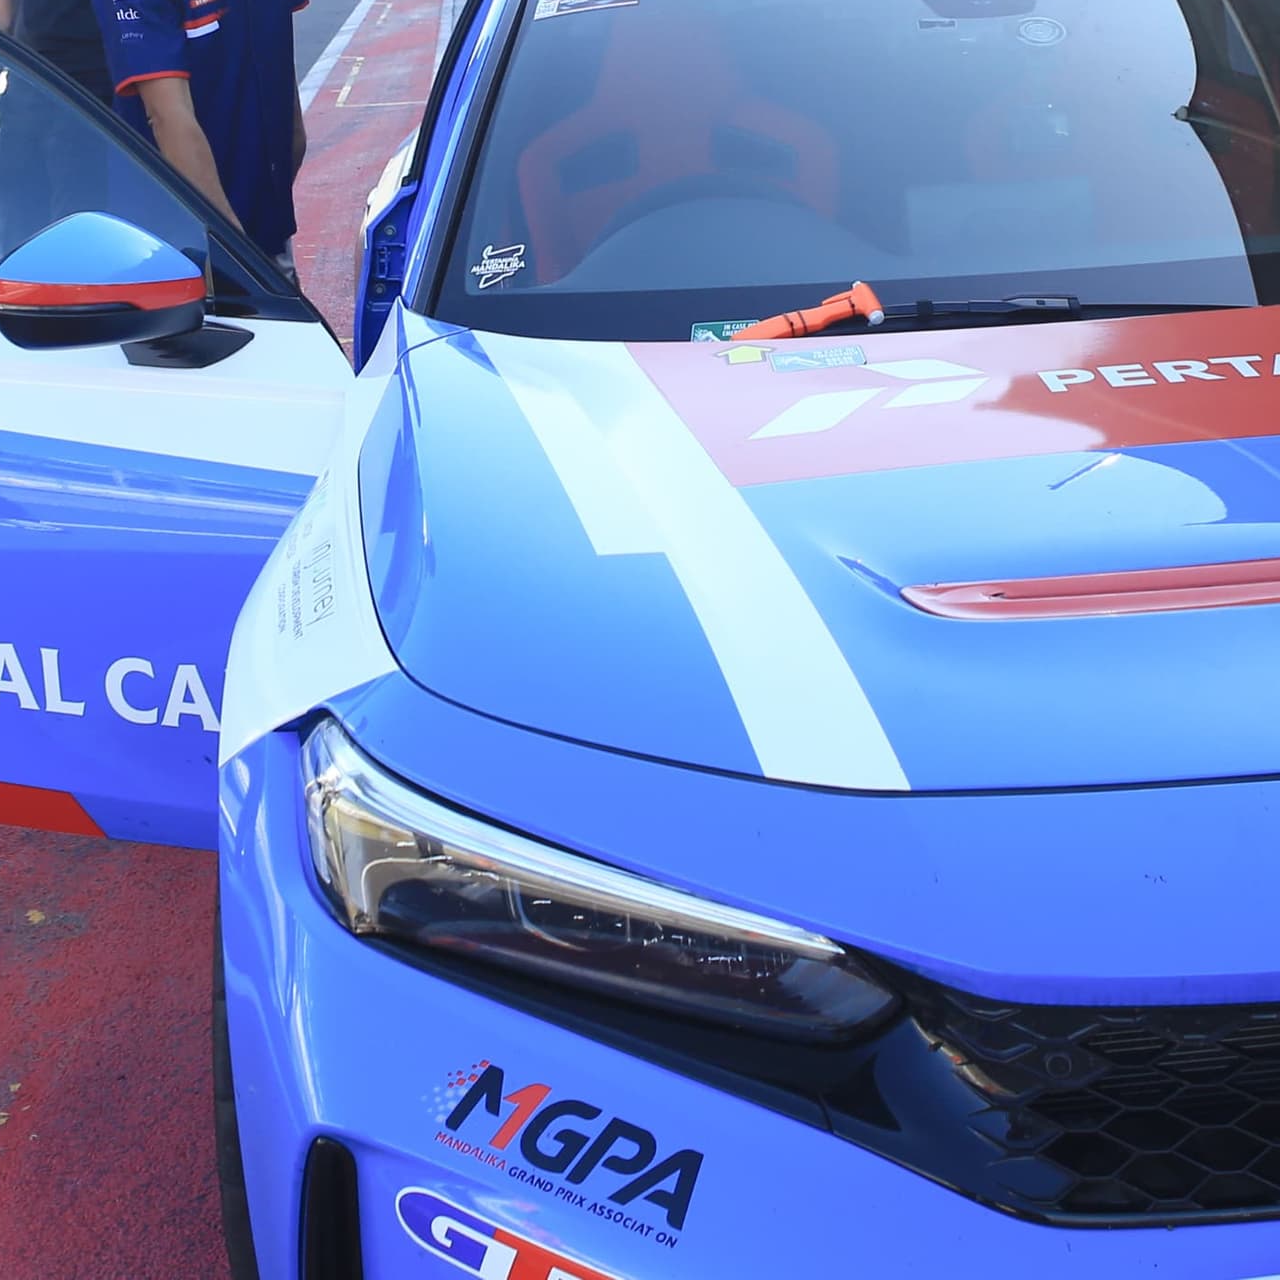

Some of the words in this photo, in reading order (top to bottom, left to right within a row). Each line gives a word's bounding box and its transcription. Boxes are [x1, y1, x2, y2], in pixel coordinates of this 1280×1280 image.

[104, 656, 221, 732] CA
[434, 1130, 508, 1171] MANDALIKA
[508, 1165, 553, 1194] GRAND
[555, 1186, 587, 1209] PRIX
[587, 1201, 679, 1249] ASSOCIATON
